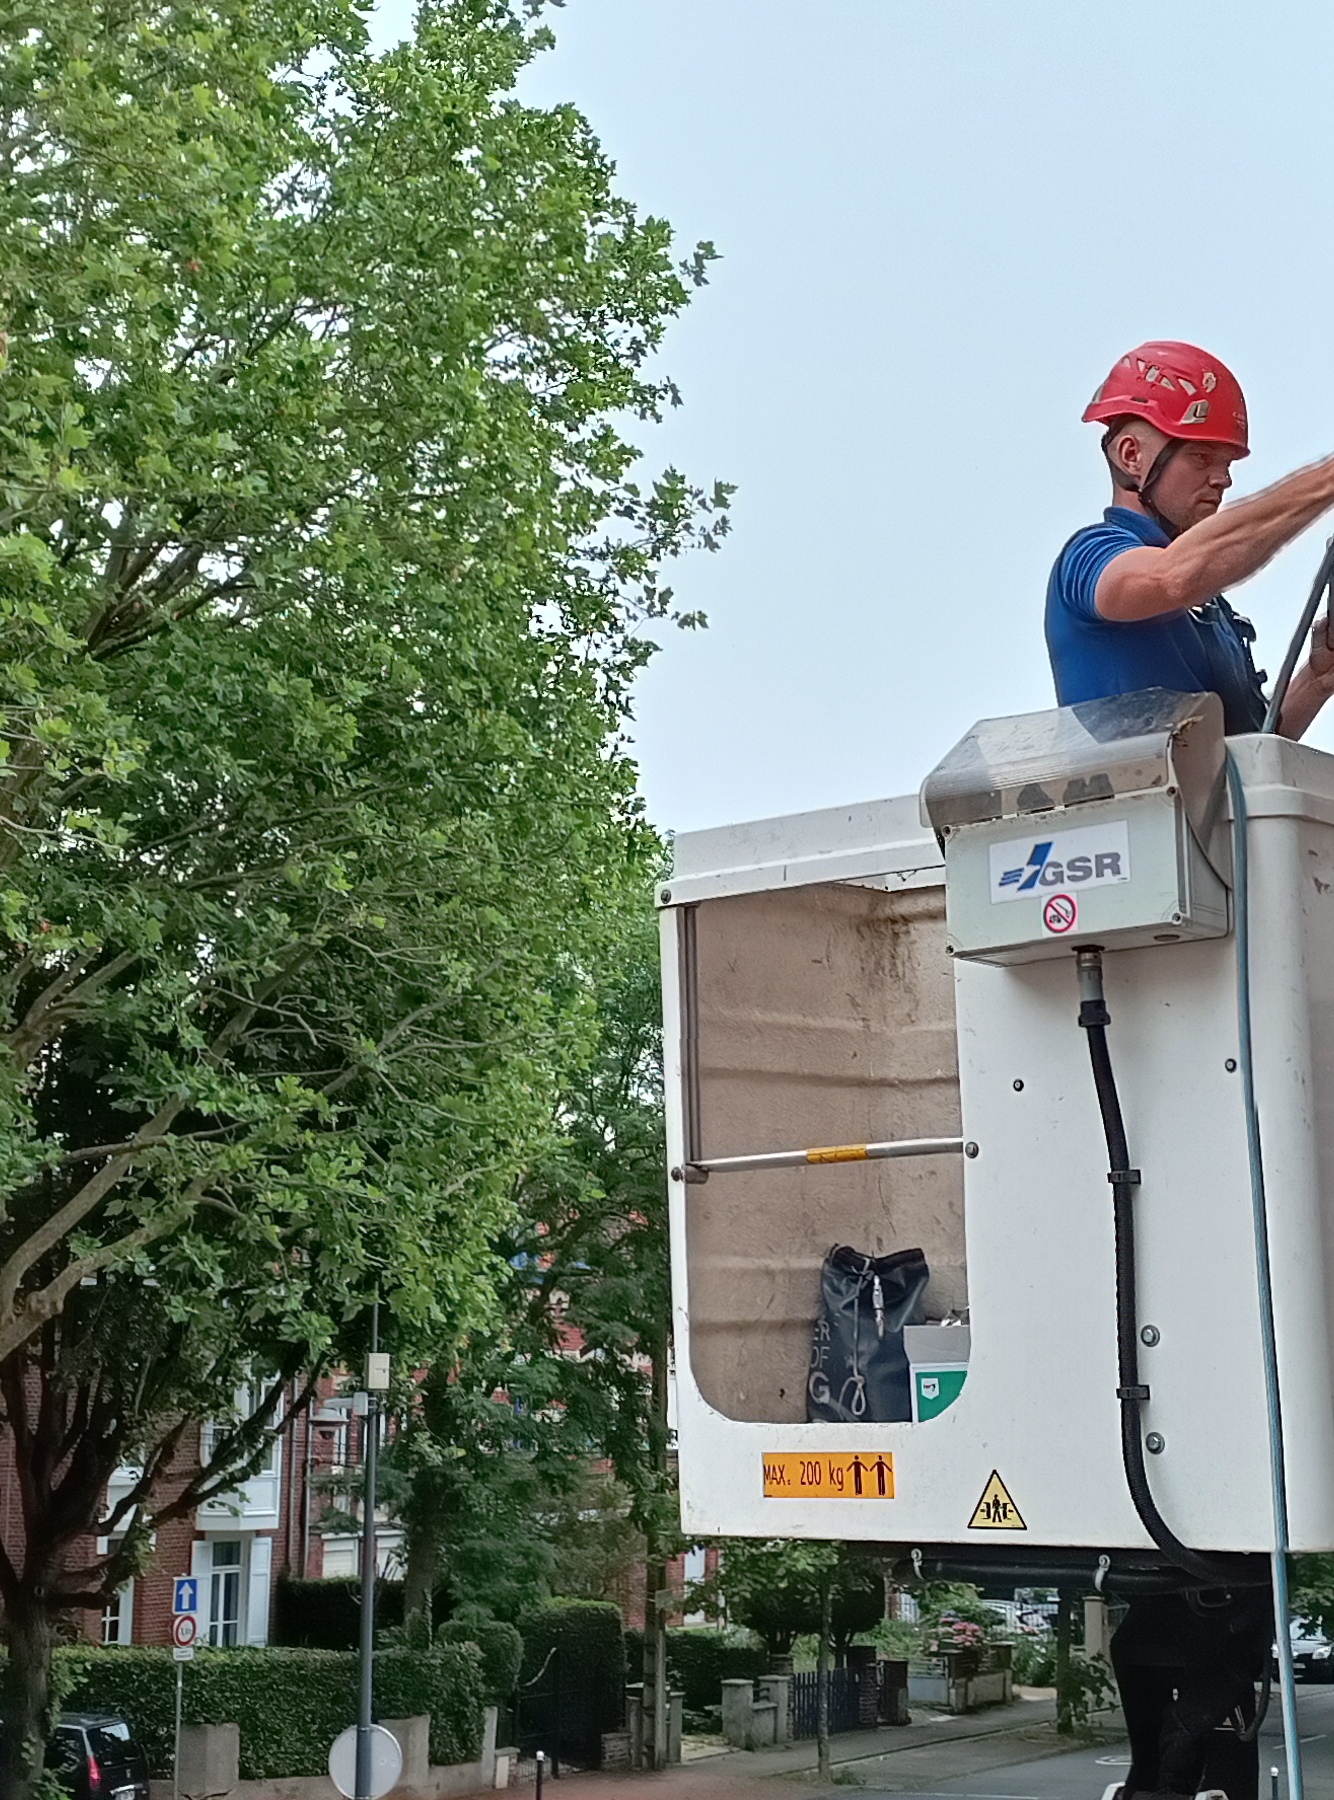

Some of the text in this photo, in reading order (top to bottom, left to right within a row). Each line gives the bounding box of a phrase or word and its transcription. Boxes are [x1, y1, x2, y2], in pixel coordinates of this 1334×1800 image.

[1038, 852, 1122, 887] GSR
[800, 1460, 822, 1486] 200
[828, 1459, 844, 1491] kg
